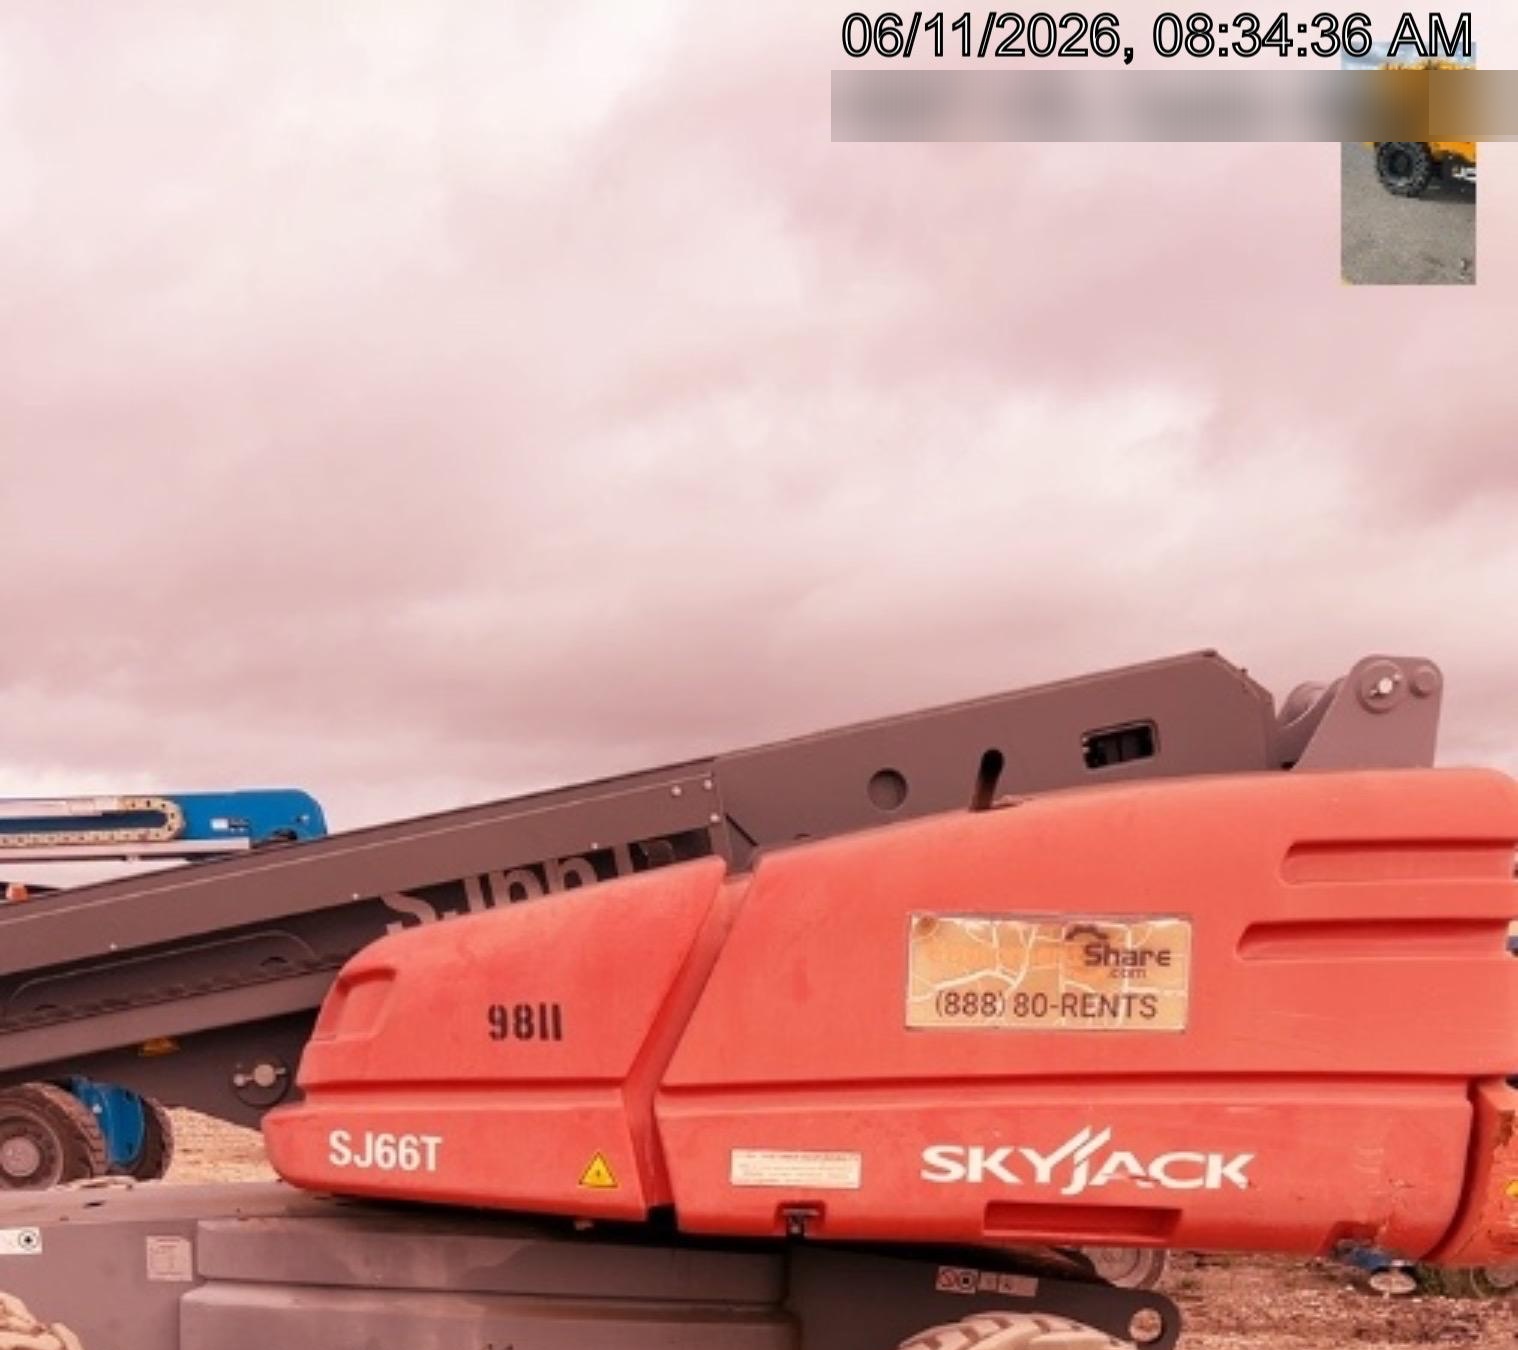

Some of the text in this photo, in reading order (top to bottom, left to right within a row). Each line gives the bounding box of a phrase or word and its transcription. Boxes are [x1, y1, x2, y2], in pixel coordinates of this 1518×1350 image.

[1083, 943, 1171, 967] Share
[487, 1003, 562, 1041] 9811
[935, 990, 1159, 1019] (888) 80-RENTS
[328, 1129, 443, 1172] SJ66T
[920, 1125, 1255, 1196] SKYJACK
